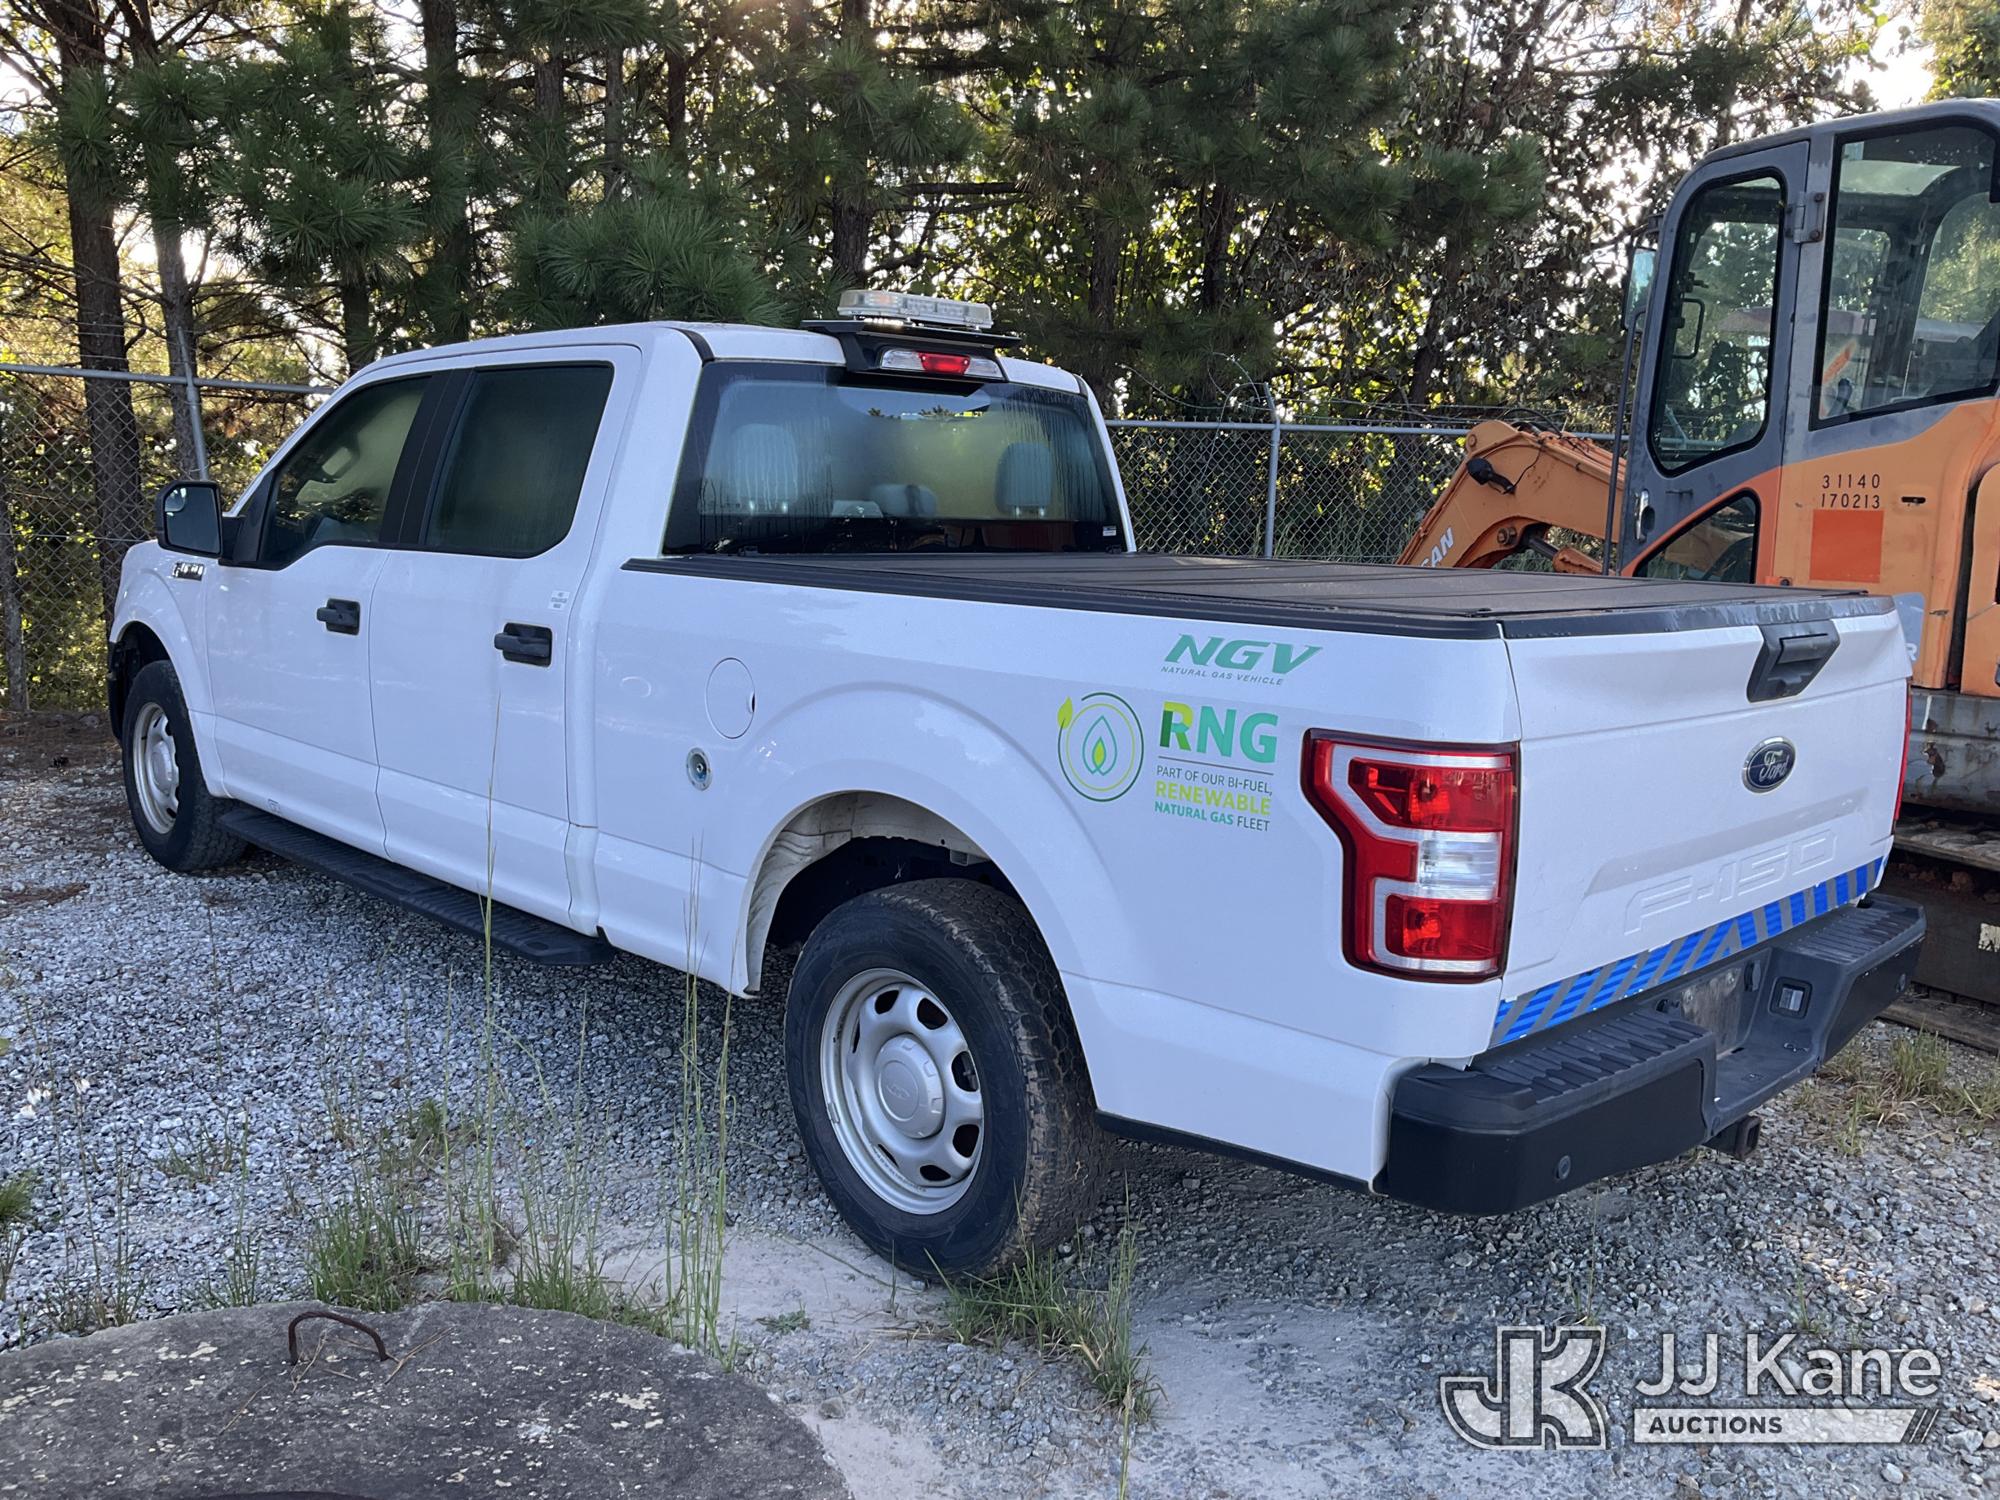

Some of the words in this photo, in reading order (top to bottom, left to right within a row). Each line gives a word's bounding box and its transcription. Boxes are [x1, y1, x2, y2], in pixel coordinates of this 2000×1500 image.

[1822, 474, 1880, 489] 31140
[1821, 493, 1880, 509] 170213
[1164, 634, 1323, 675] NGV
[1160, 666, 1208, 678] NATURAL
[1211, 671, 1233, 681] GAS
[1236, 674, 1284, 686] VEHICLE
[1159, 701, 1279, 764] RNG
[1156, 765, 1182, 779] PART
[1184, 770, 1199, 782] OF
[1201, 773, 1225, 786] OUR
[1227, 776, 1273, 797] BI-FUEL,
[1758, 750, 1790, 783] Ford
[1155, 779, 1271, 816] RENEWABLE
[1154, 801, 1208, 821] NATURAL
[1210, 811, 1234, 825] GAS
[1236, 816, 1271, 832] FLEET
[1623, 828, 1838, 936] F-150
